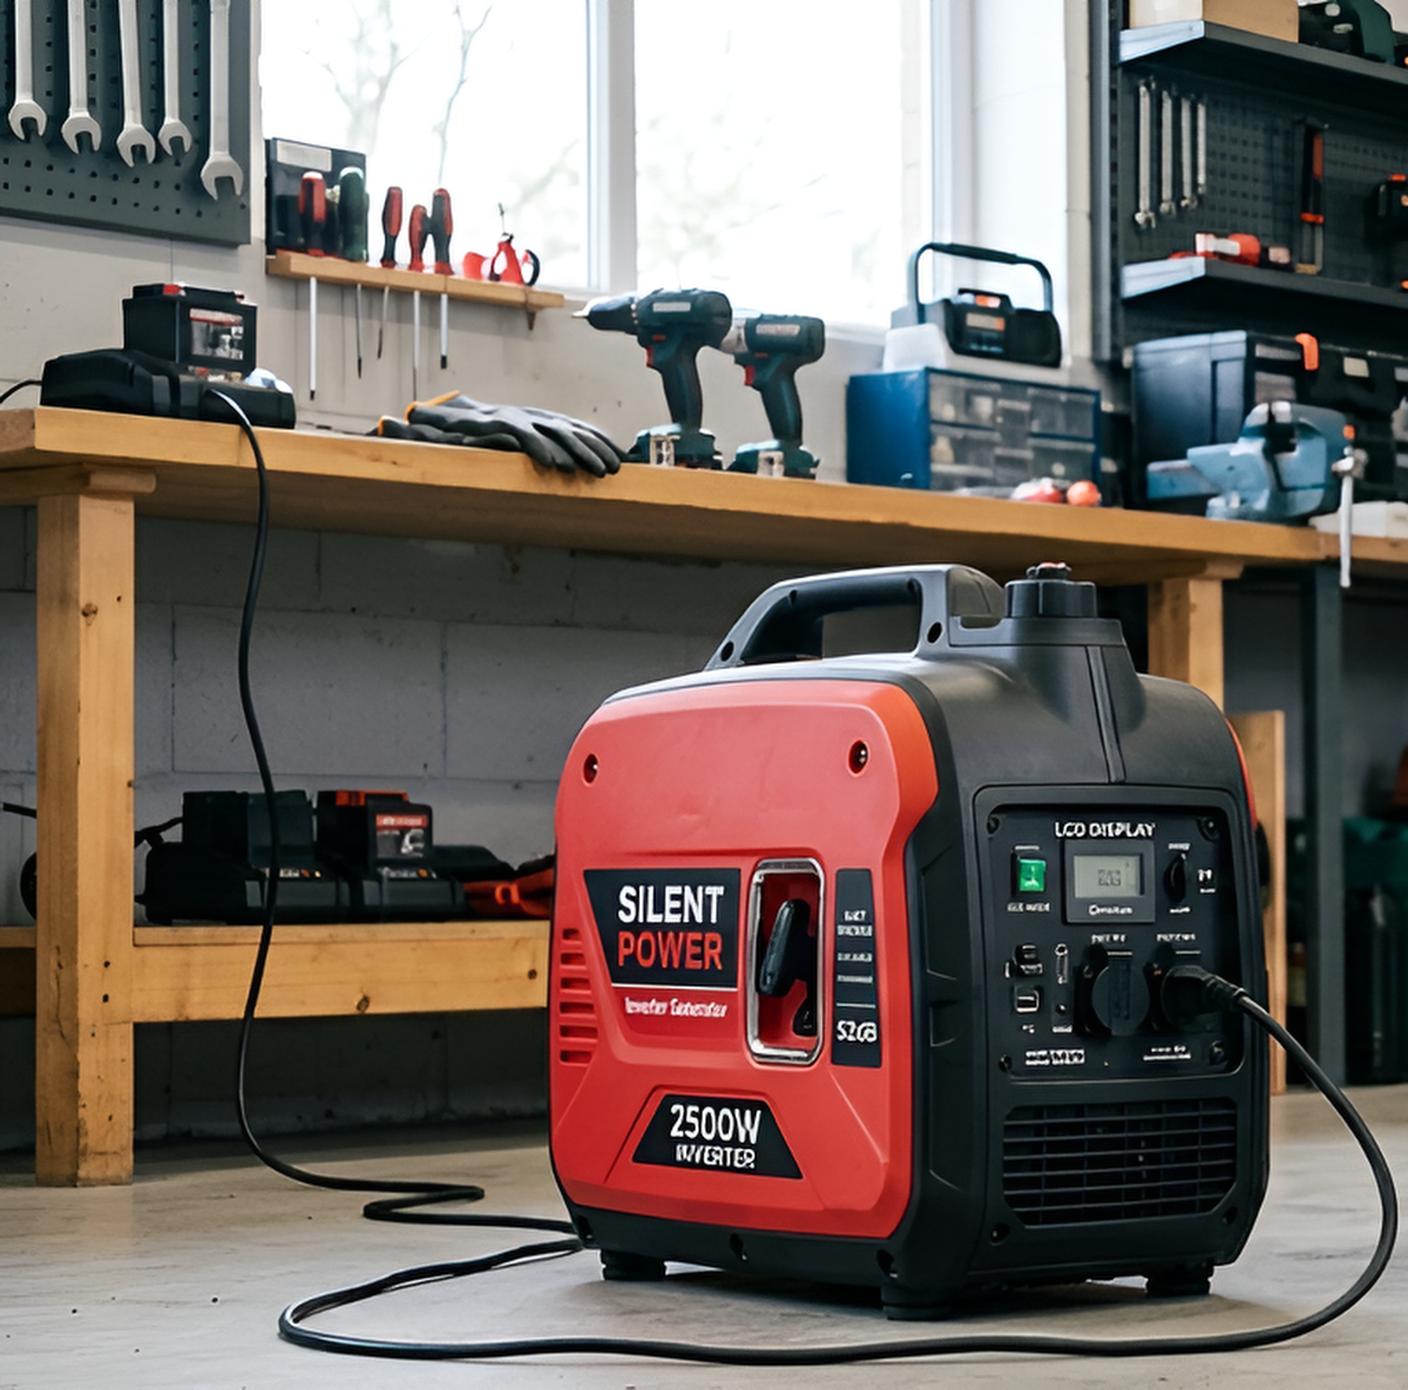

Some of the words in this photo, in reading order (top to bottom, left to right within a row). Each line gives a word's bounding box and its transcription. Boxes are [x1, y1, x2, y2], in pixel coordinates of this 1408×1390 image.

[618, 885, 725, 924] SILENT
[618, 930, 723, 970] POWER
[670, 1104, 761, 1144] 2500W
